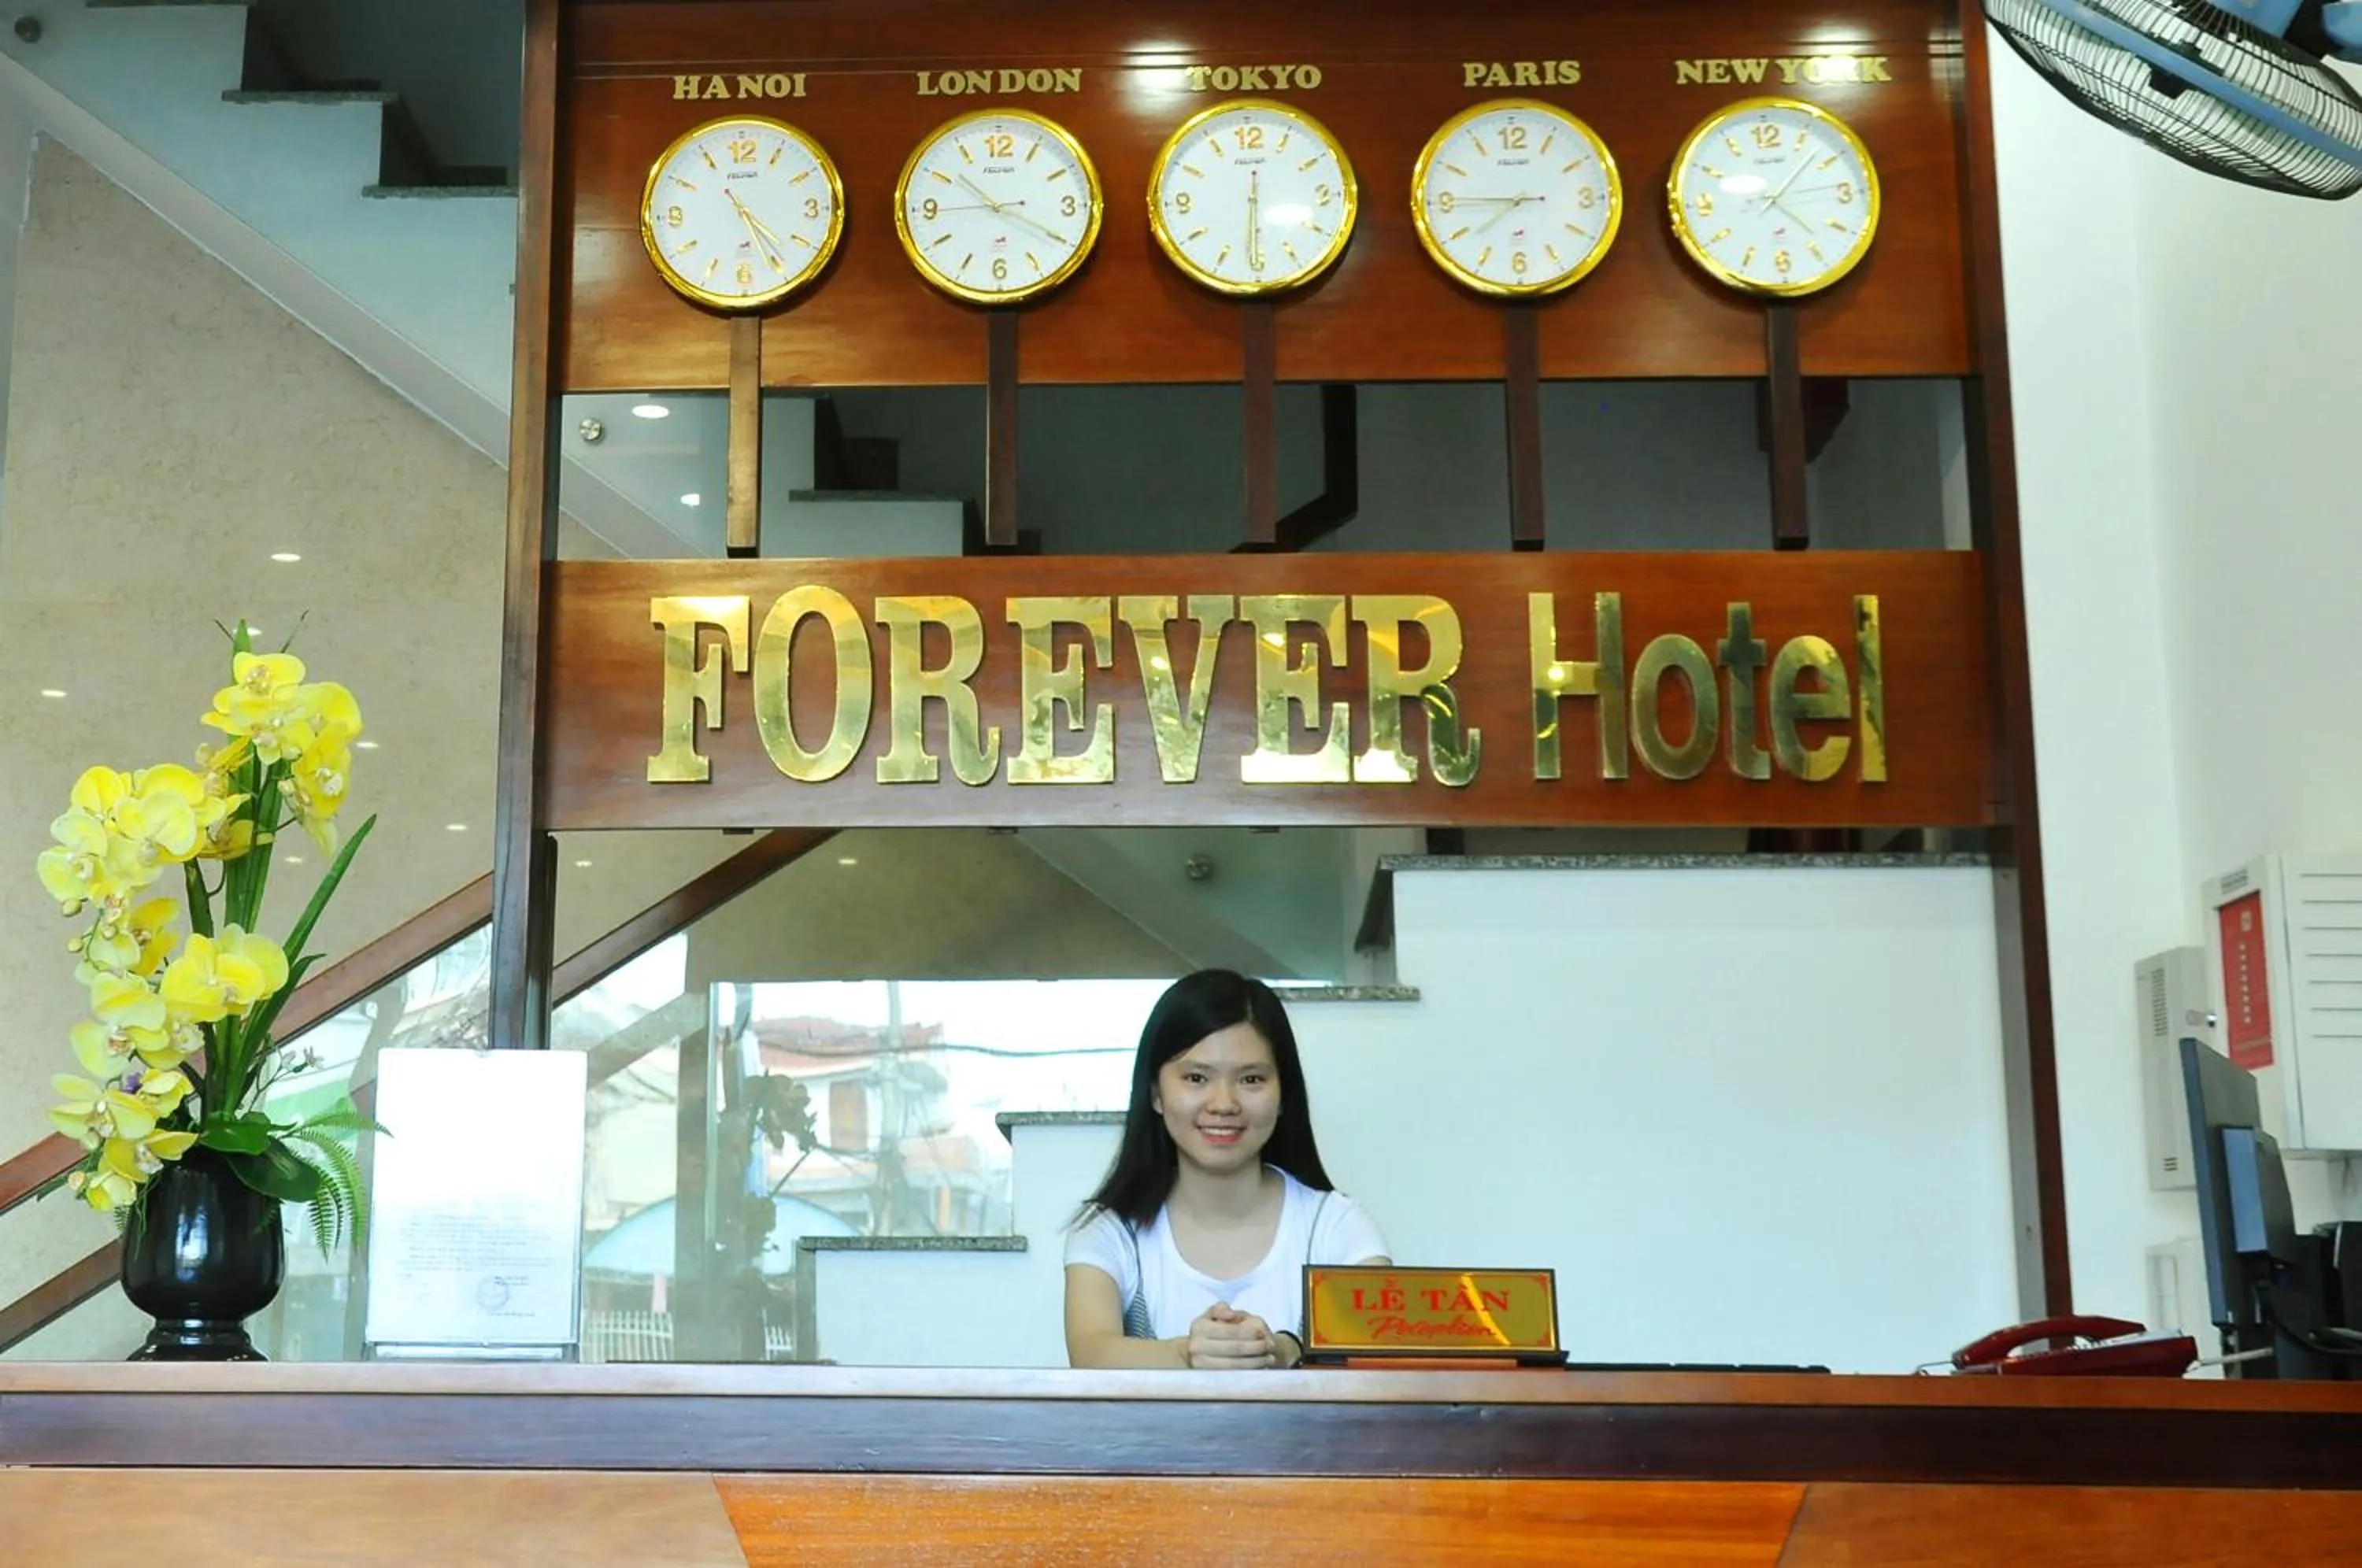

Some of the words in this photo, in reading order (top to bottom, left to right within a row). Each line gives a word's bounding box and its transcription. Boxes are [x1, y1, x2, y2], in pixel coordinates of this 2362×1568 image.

[916, 68, 1083, 96] LONDON
[1186, 65, 1322, 92] TOKYO
[1463, 60, 1582, 87] PARIS
[1675, 58, 1768, 85] NEW
[985, 134, 1013, 157] 12
[1235, 128, 1264, 149] 12
[1498, 128, 1527, 149] 12
[1751, 124, 1781, 148] 12
[727, 139, 757, 163] 12
[1578, 187, 1595, 208] 3
[1837, 183, 1853, 204] 3
[804, 198, 818, 218] 3
[922, 198, 939, 219] 9
[1061, 196, 1076, 216] 3
[992, 258, 1007, 279] 6
[1512, 252, 1527, 273] 6
[646, 583, 1483, 788] FOREVER
[1529, 590, 1888, 782] Hotel
